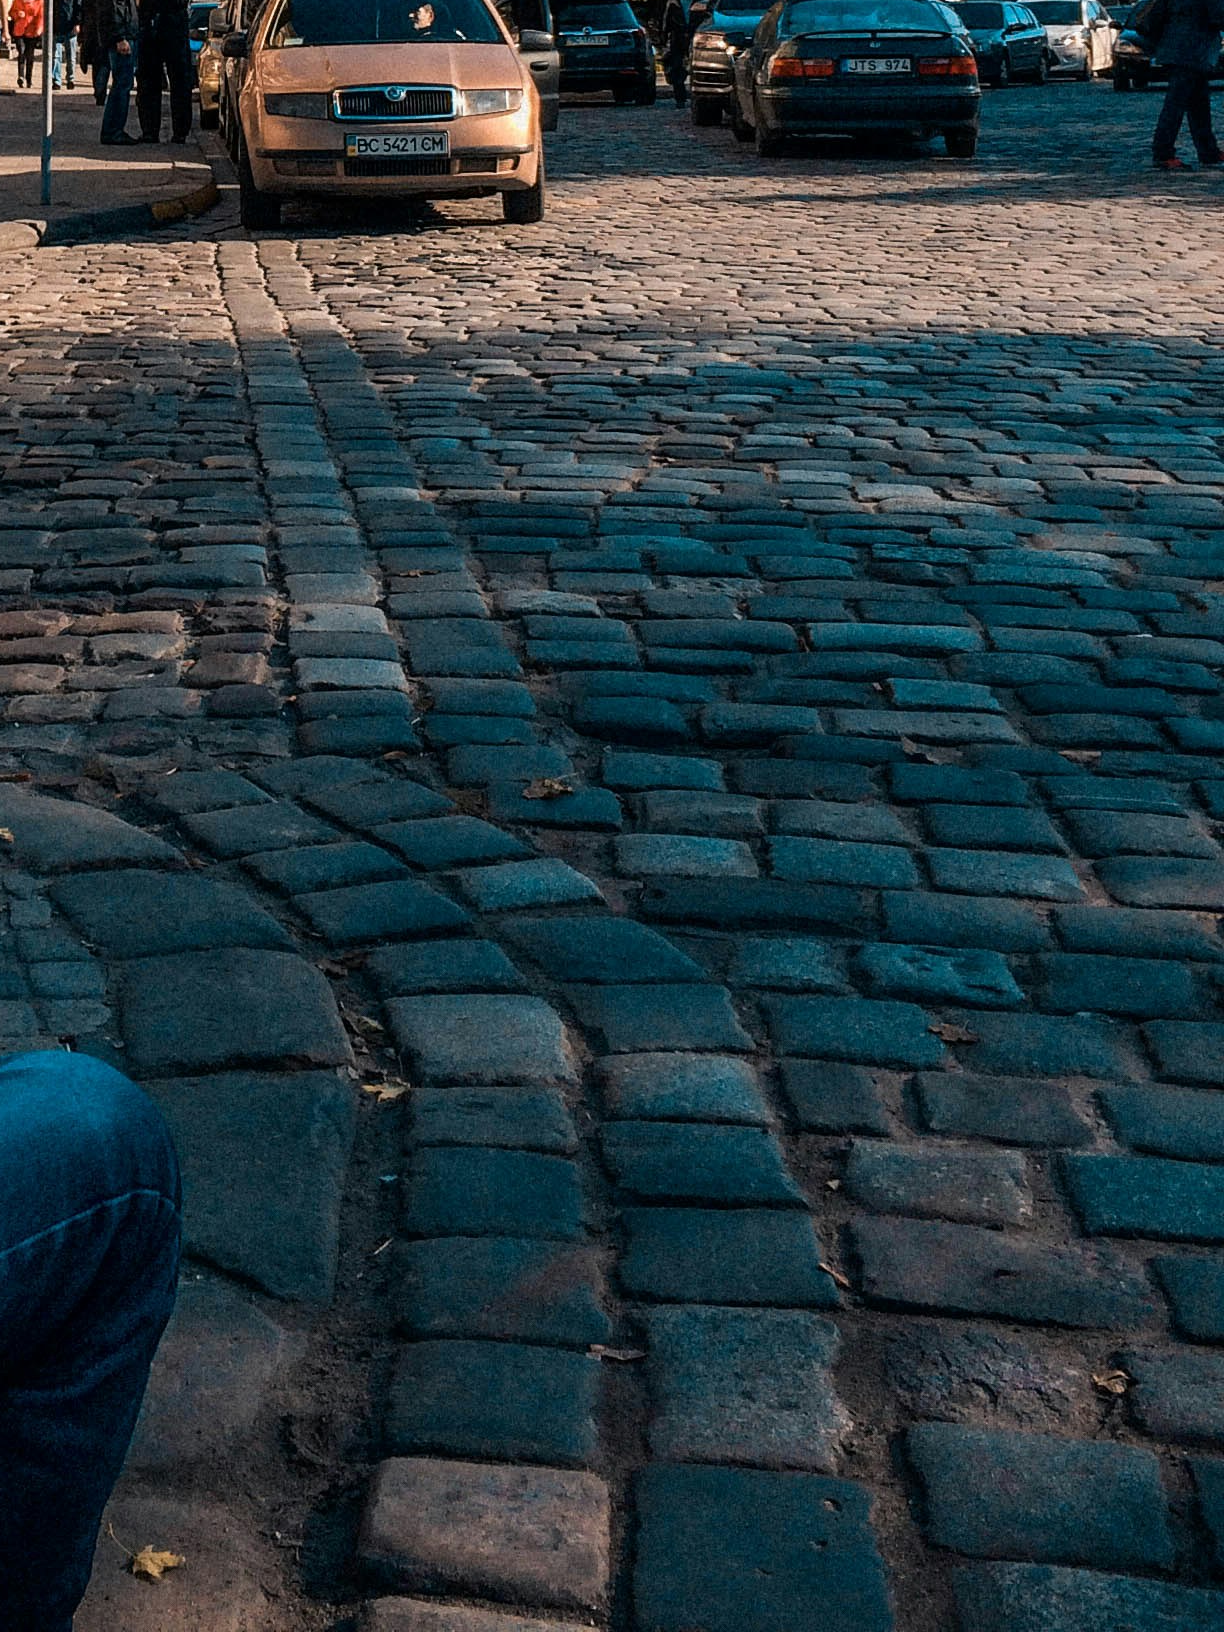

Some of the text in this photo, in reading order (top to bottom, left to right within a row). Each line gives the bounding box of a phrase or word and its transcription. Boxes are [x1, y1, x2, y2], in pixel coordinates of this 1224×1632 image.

[849, 60, 908, 71] JTS 974
[357, 137, 444, 153] BC 5421 CM
